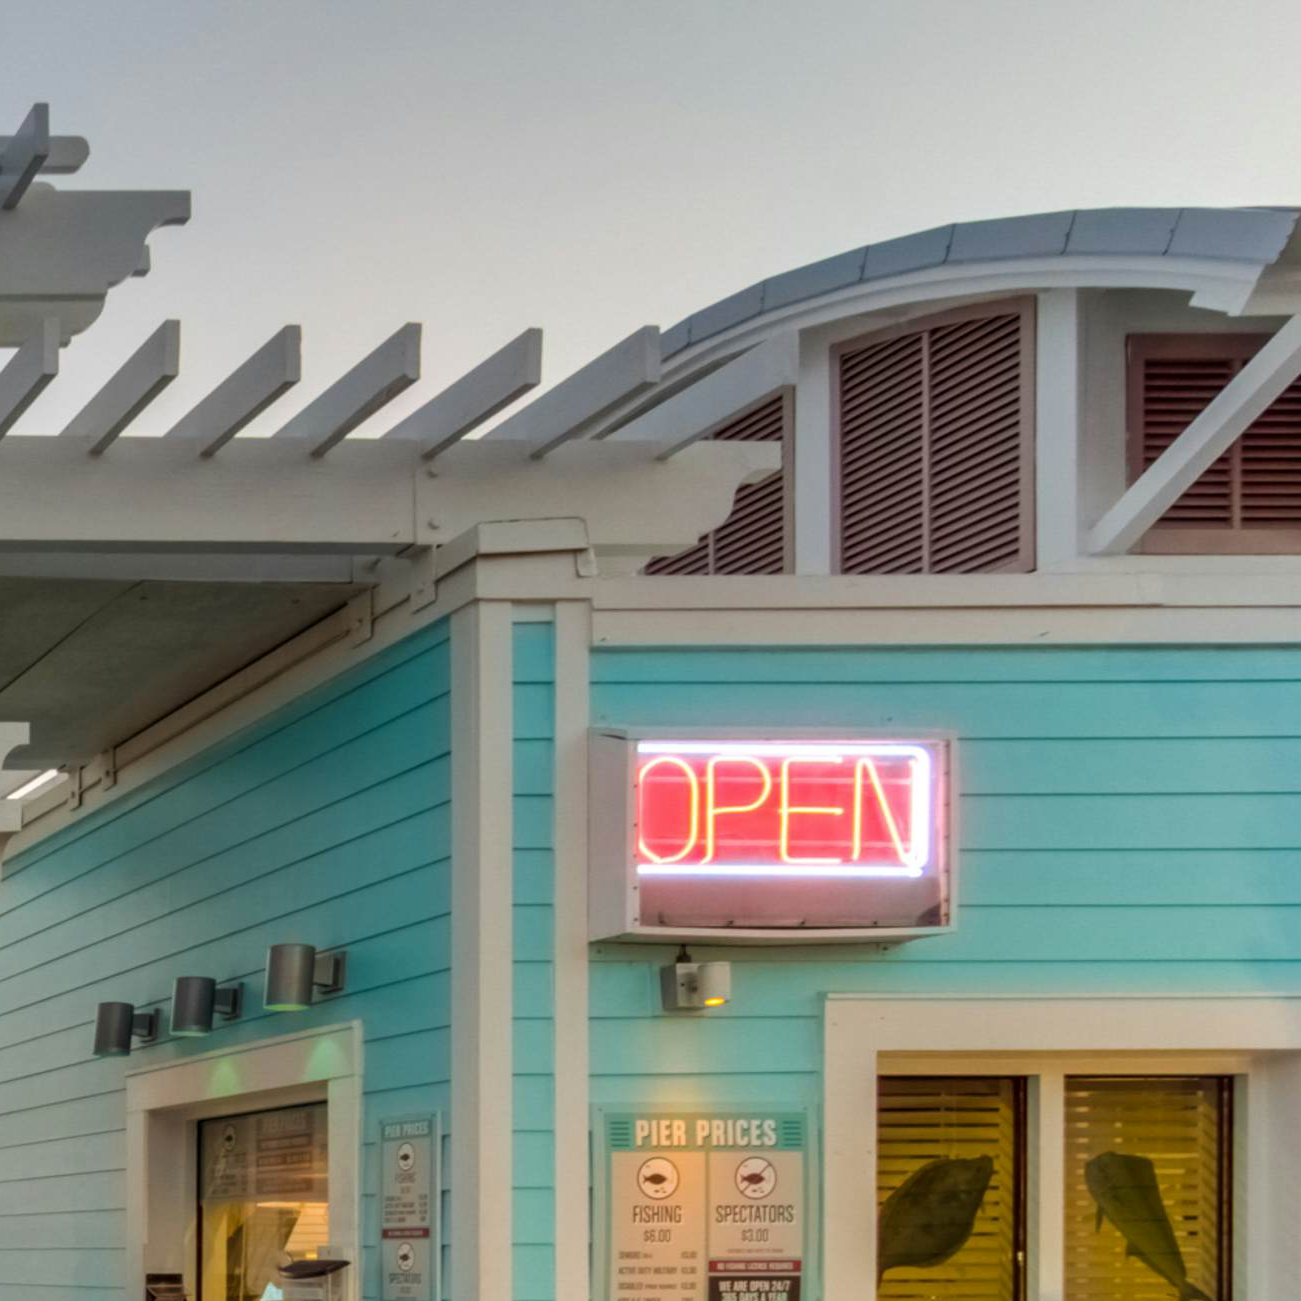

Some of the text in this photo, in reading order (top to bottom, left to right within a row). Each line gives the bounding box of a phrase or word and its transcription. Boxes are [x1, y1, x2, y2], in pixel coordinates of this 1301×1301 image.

[637, 755, 919, 866] OPEN
[635, 1119, 777, 1146] PIER PRICES
[632, 1204, 682, 1223] FISHING
[715, 1204, 794, 1223] SPECTATORS
[643, 1228, 671, 1242] $6.00
[741, 1228, 769, 1242] $3.00
[718, 1280, 791, 1292] WE ARE OPEN 24/7
